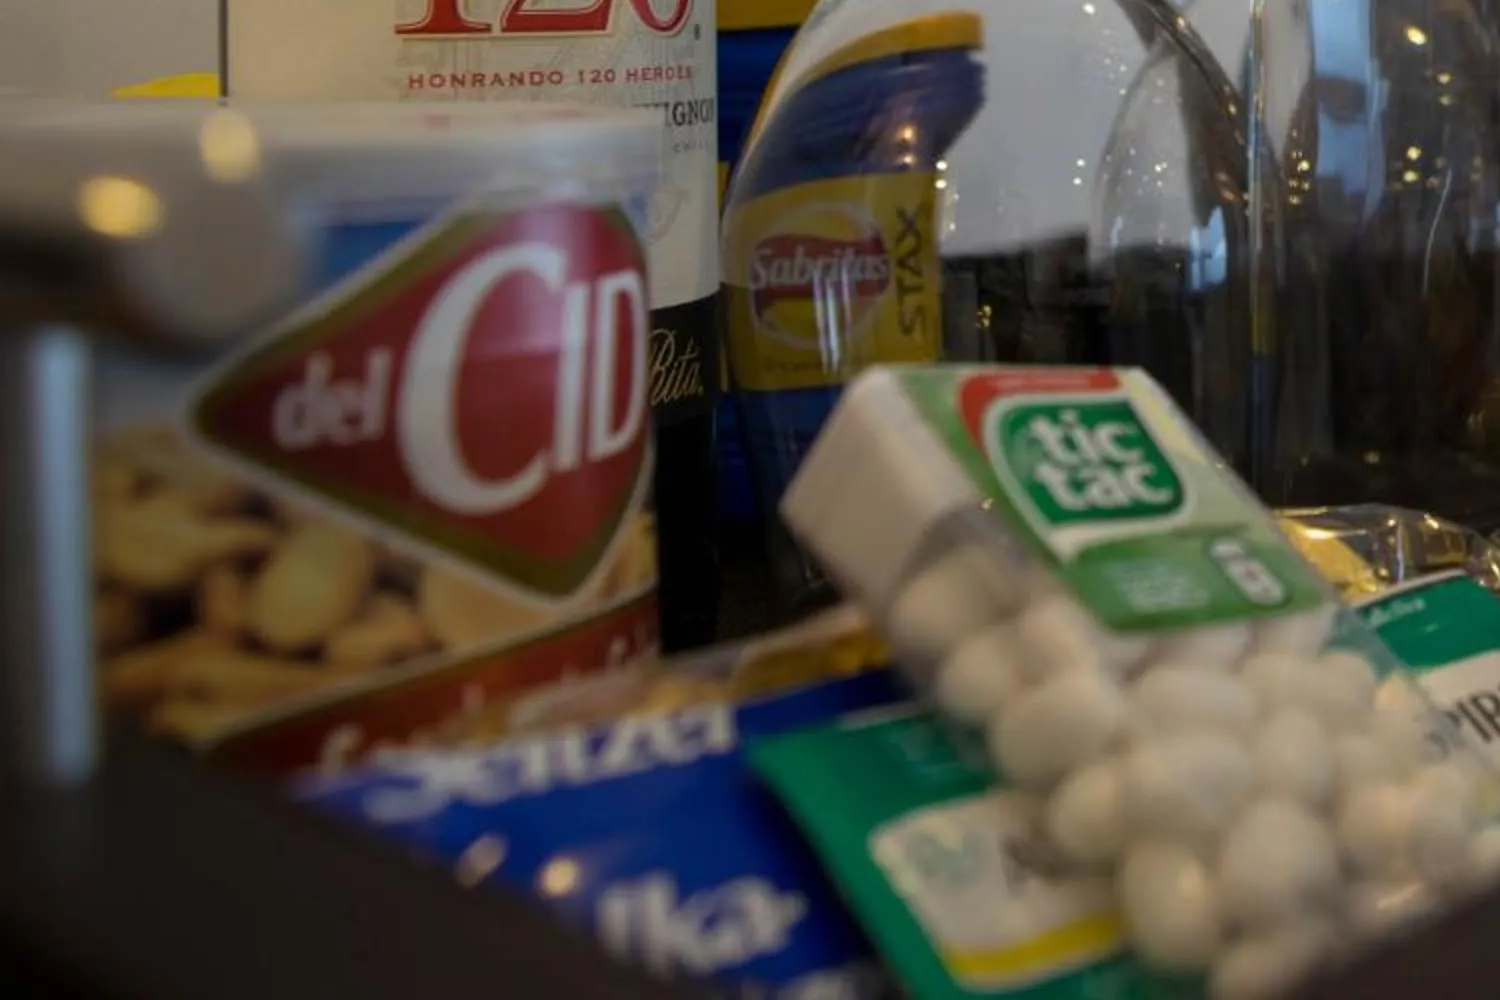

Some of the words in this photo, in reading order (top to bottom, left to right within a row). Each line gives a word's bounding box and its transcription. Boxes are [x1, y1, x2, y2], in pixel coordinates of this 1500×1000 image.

[408, 70, 565, 90] HONRANDO
[577, 68, 617, 84] 120
[751, 241, 891, 290] Sabritas
[273, 345, 392, 450] del
[398, 241, 647, 516] CID
[1028, 408, 1142, 466] tic
[1033, 462, 1174, 512] tac
